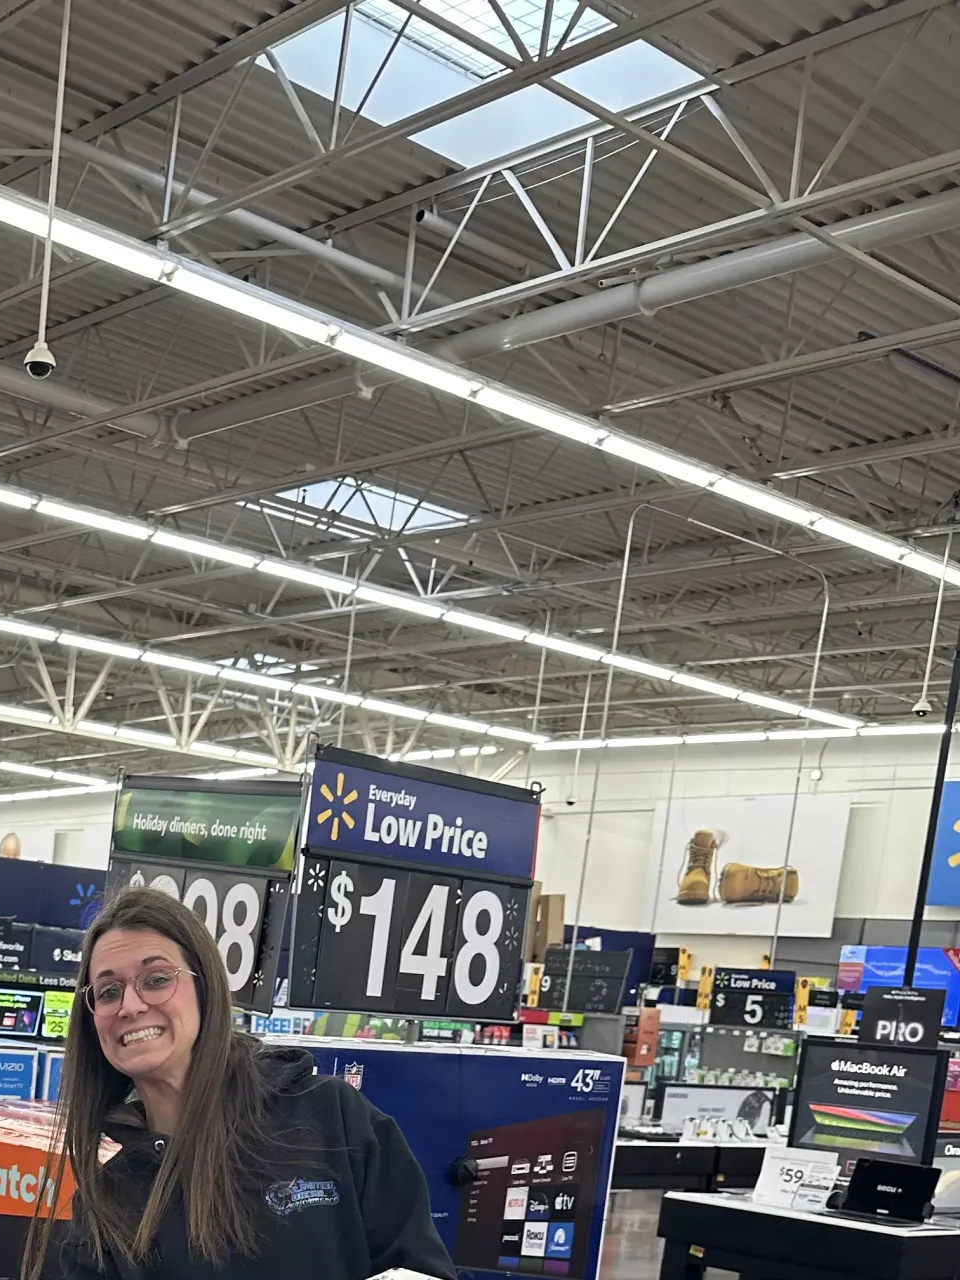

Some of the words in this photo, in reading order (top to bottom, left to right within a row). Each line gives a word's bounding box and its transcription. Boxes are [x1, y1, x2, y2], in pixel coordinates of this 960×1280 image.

[368, 784, 417, 810] Everyday
[133, 813, 168, 836] Holiday
[169, 817, 209, 838] dinners,
[210, 818, 238, 838] done
[239, 821, 267, 843] right
[364, 802, 422, 848] Low
[424, 812, 488, 859] Price
[327, 870, 506, 1006] $148
[39, 976, 58, 986] Less
[730, 978, 751, 989] Low
[751, 980, 777, 990] Price
[743, 994, 764, 1024] 5
[527, 1074, 544, 1084] Dolby
[839, 1060, 890, 1075] MacBook
[890, 1064, 908, 1077] Air
[525, 1229, 545, 1241] Roku
